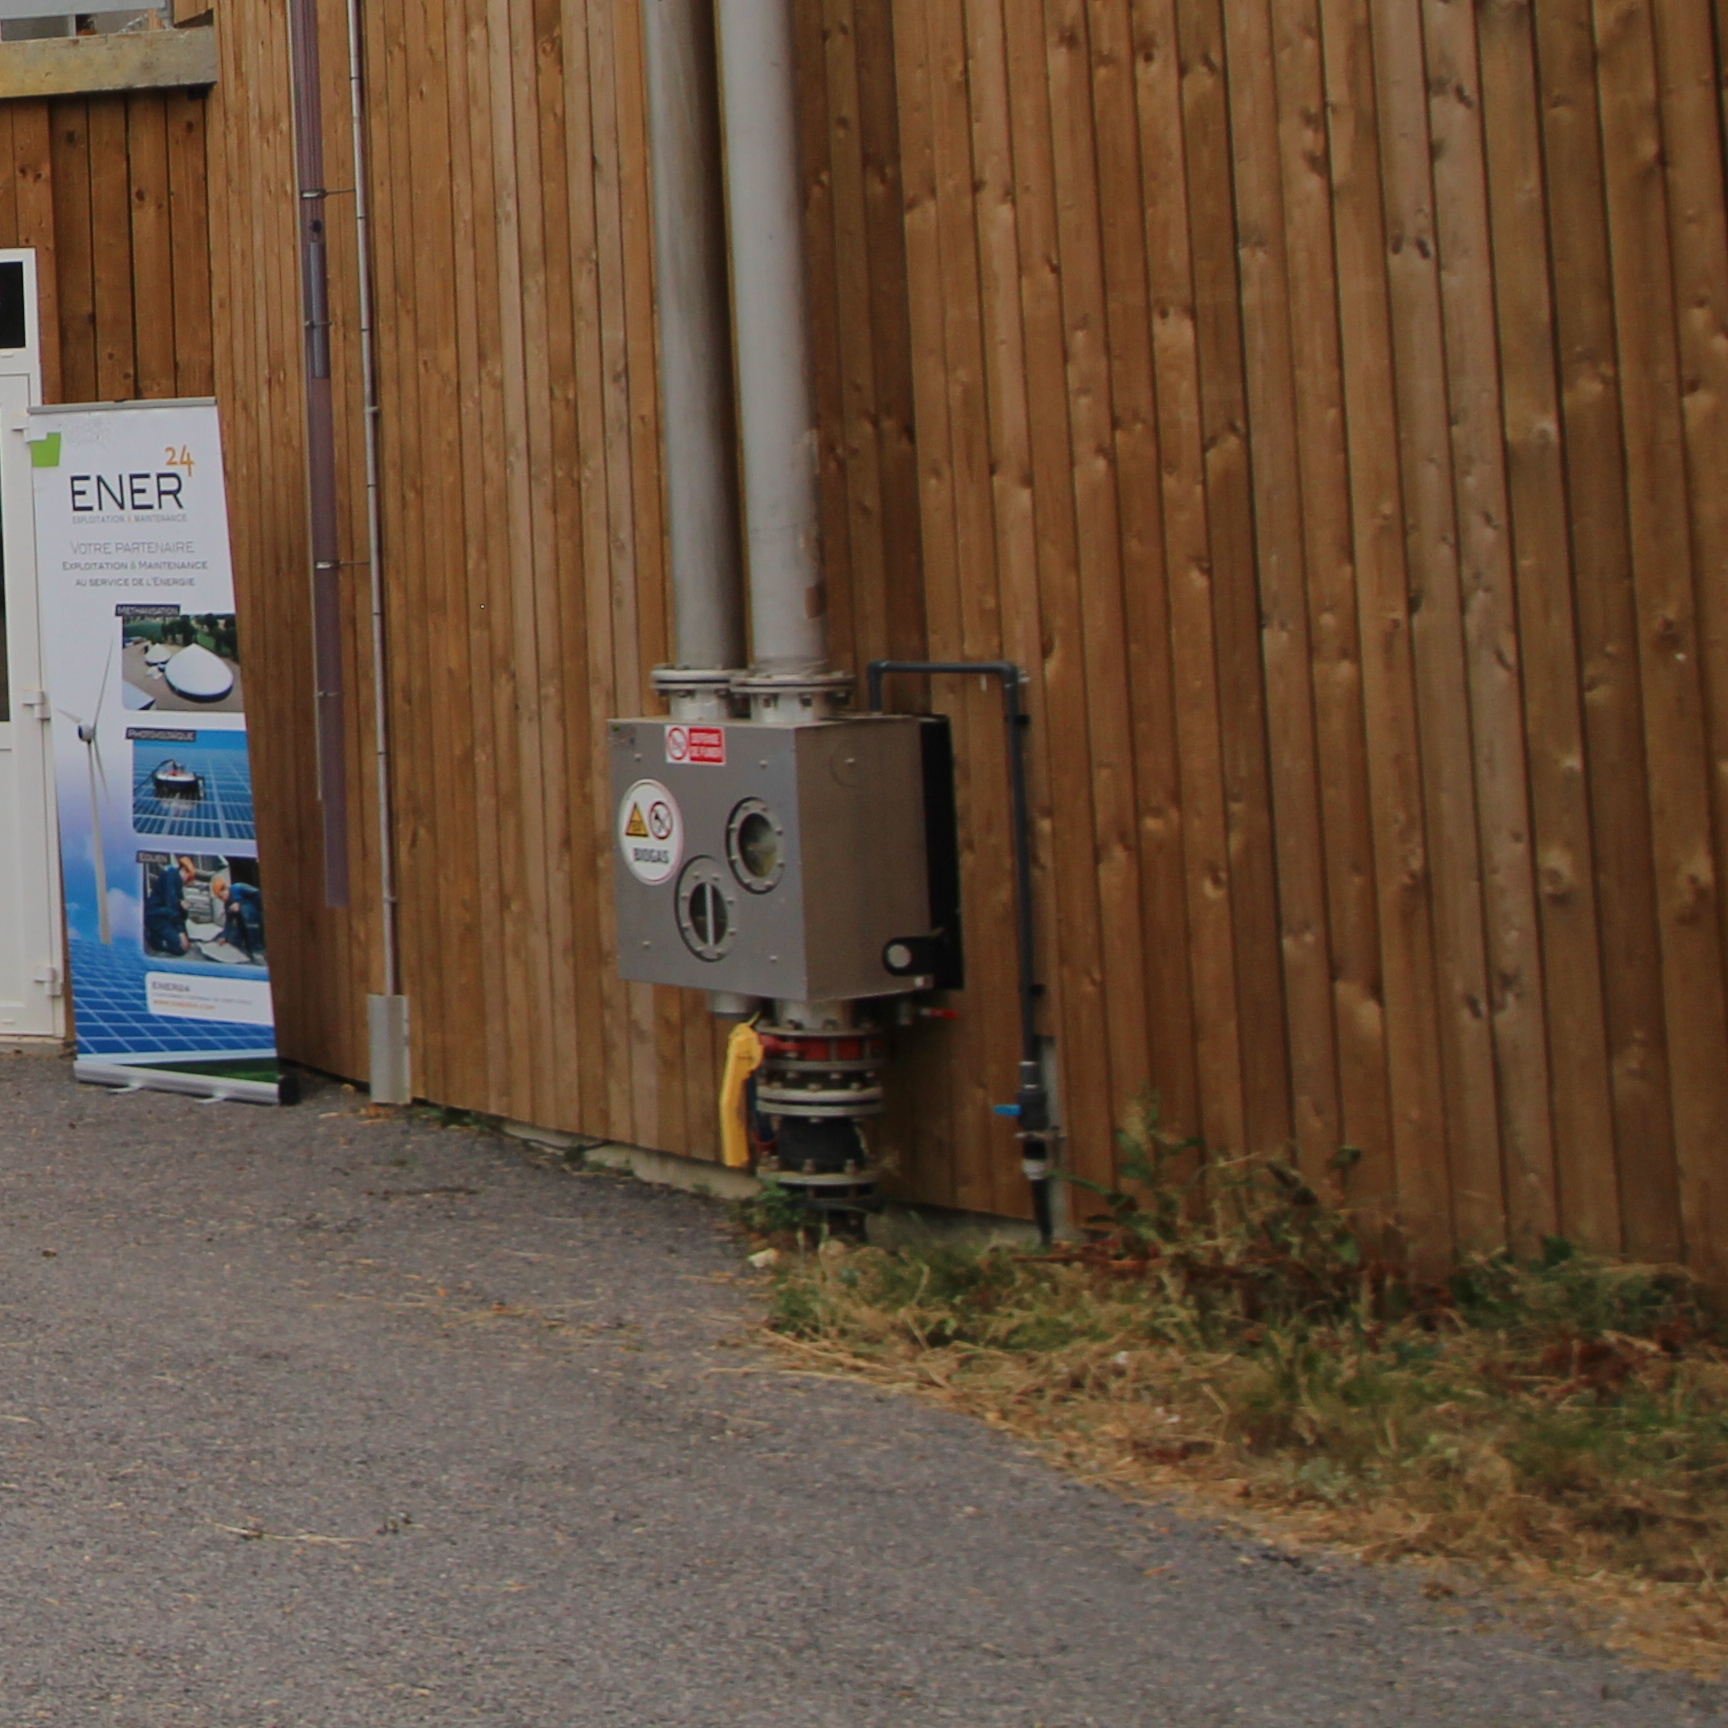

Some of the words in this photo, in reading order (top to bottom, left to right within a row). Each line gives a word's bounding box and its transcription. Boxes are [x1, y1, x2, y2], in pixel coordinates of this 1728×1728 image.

[164, 444, 196, 478] 24
[70, 472, 184, 512] ENER
[72, 514, 125, 525] EXPLOITATION
[133, 513, 187, 523] MAINTENANCE
[70, 542, 112, 555] VOTRE
[115, 541, 195, 554] PARTENAIRE
[62, 561, 129, 571] EXPLOITATION
[138, 560, 209, 571] MAINTENANCE
[89, 578, 130, 587] SERVICE
[131, 578, 144, 587] DE
[632, 847, 670, 864] BIOGAS
